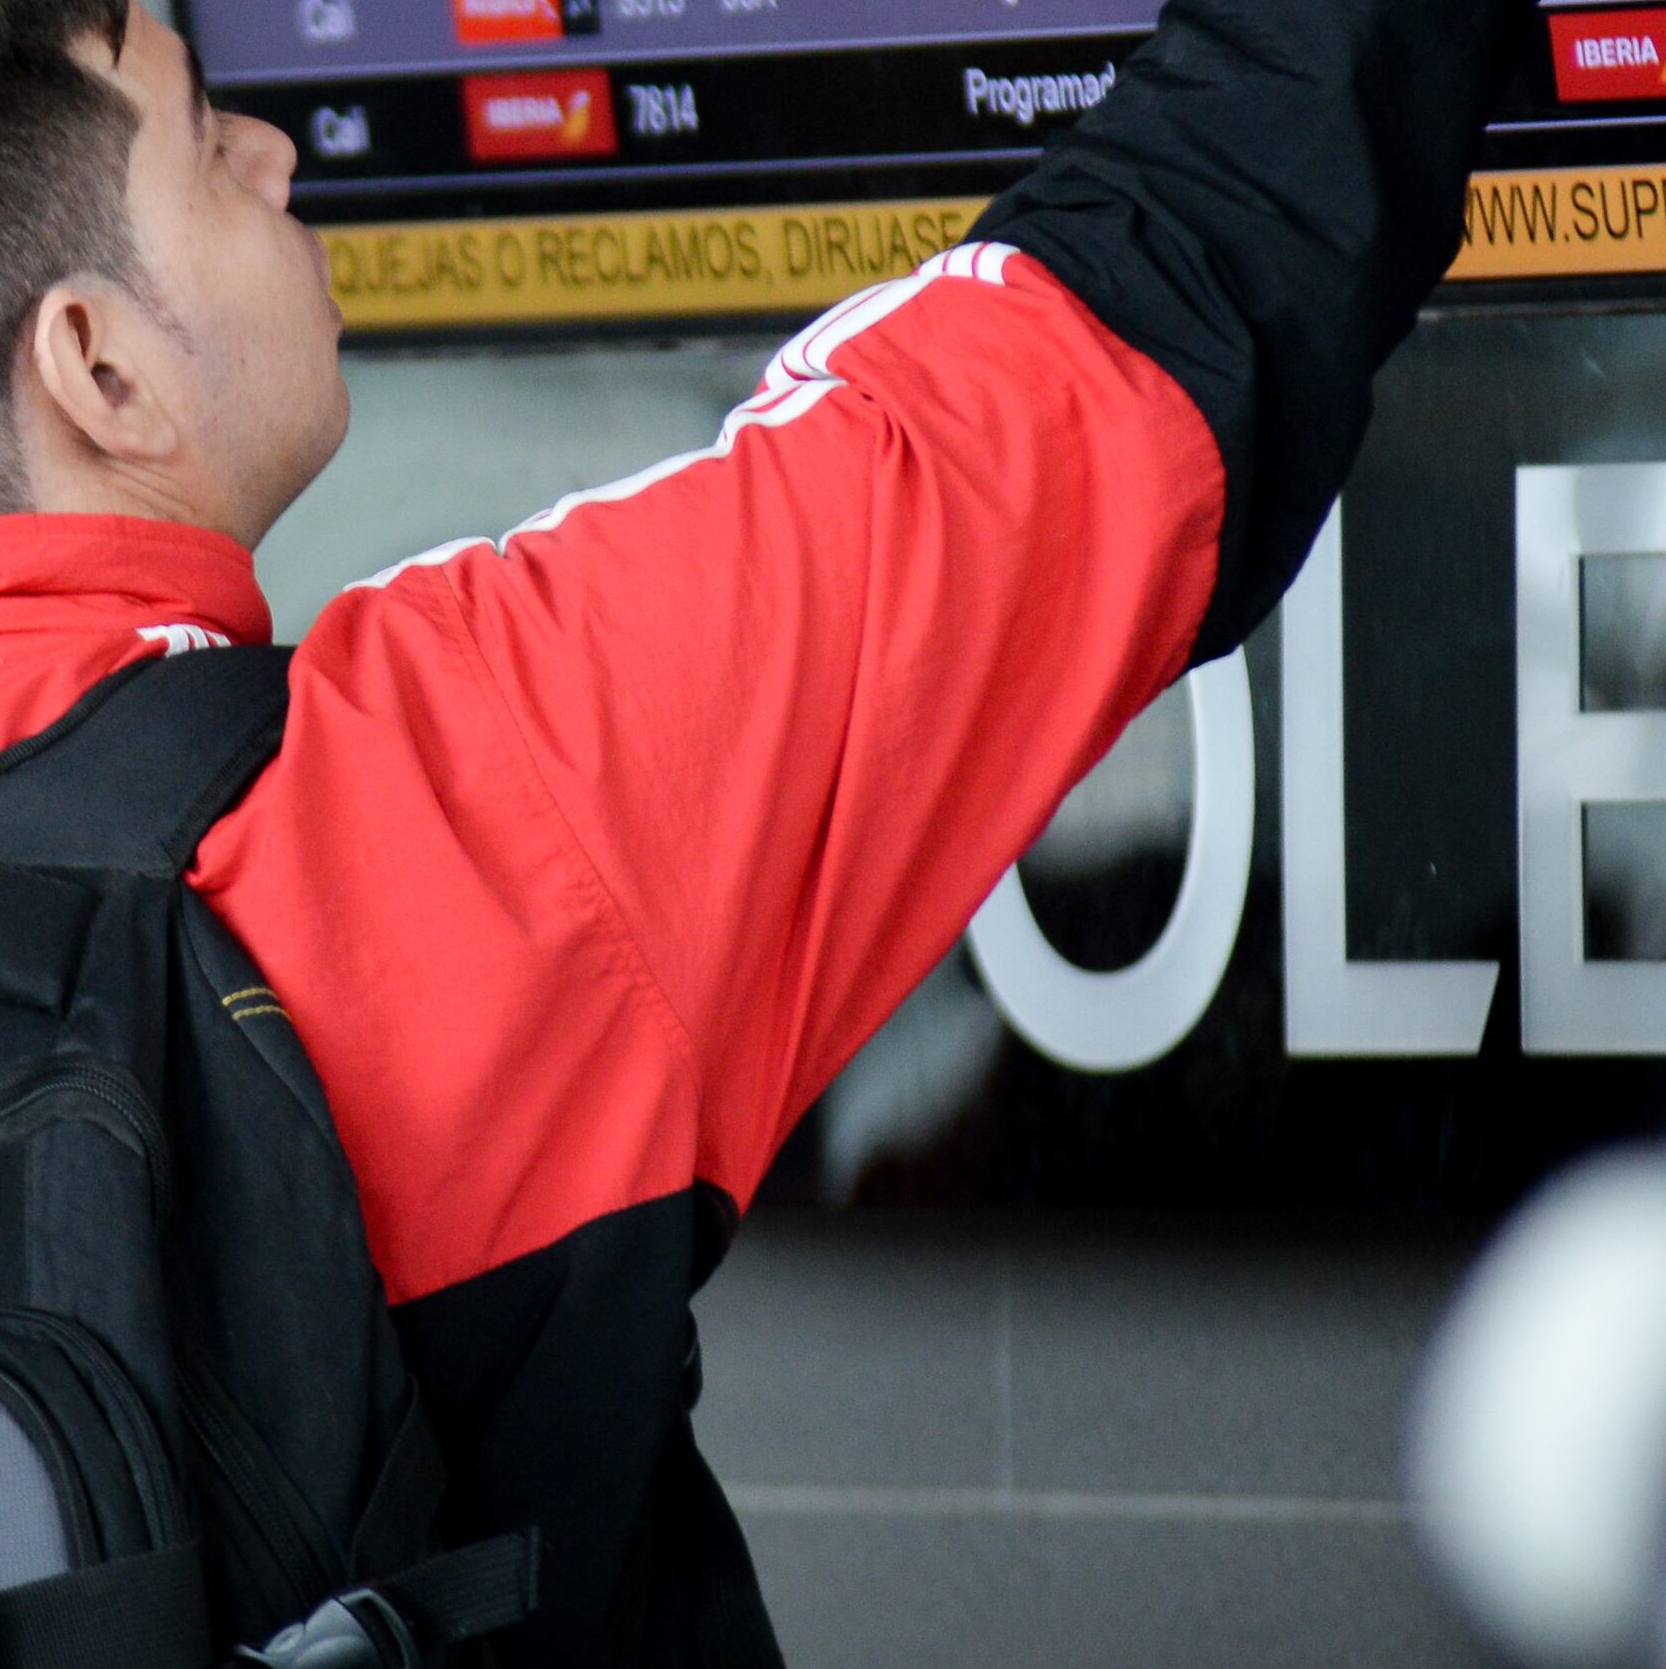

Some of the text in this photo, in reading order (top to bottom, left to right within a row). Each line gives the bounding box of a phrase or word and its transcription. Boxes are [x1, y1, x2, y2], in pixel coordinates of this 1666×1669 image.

[1574, 30, 1658, 69] IBERIA
[626, 83, 699, 135] 7814
[334, 231, 484, 294] QUEJAS
[495, 233, 527, 287] O
[538, 219, 774, 285] RECLAMOS,
